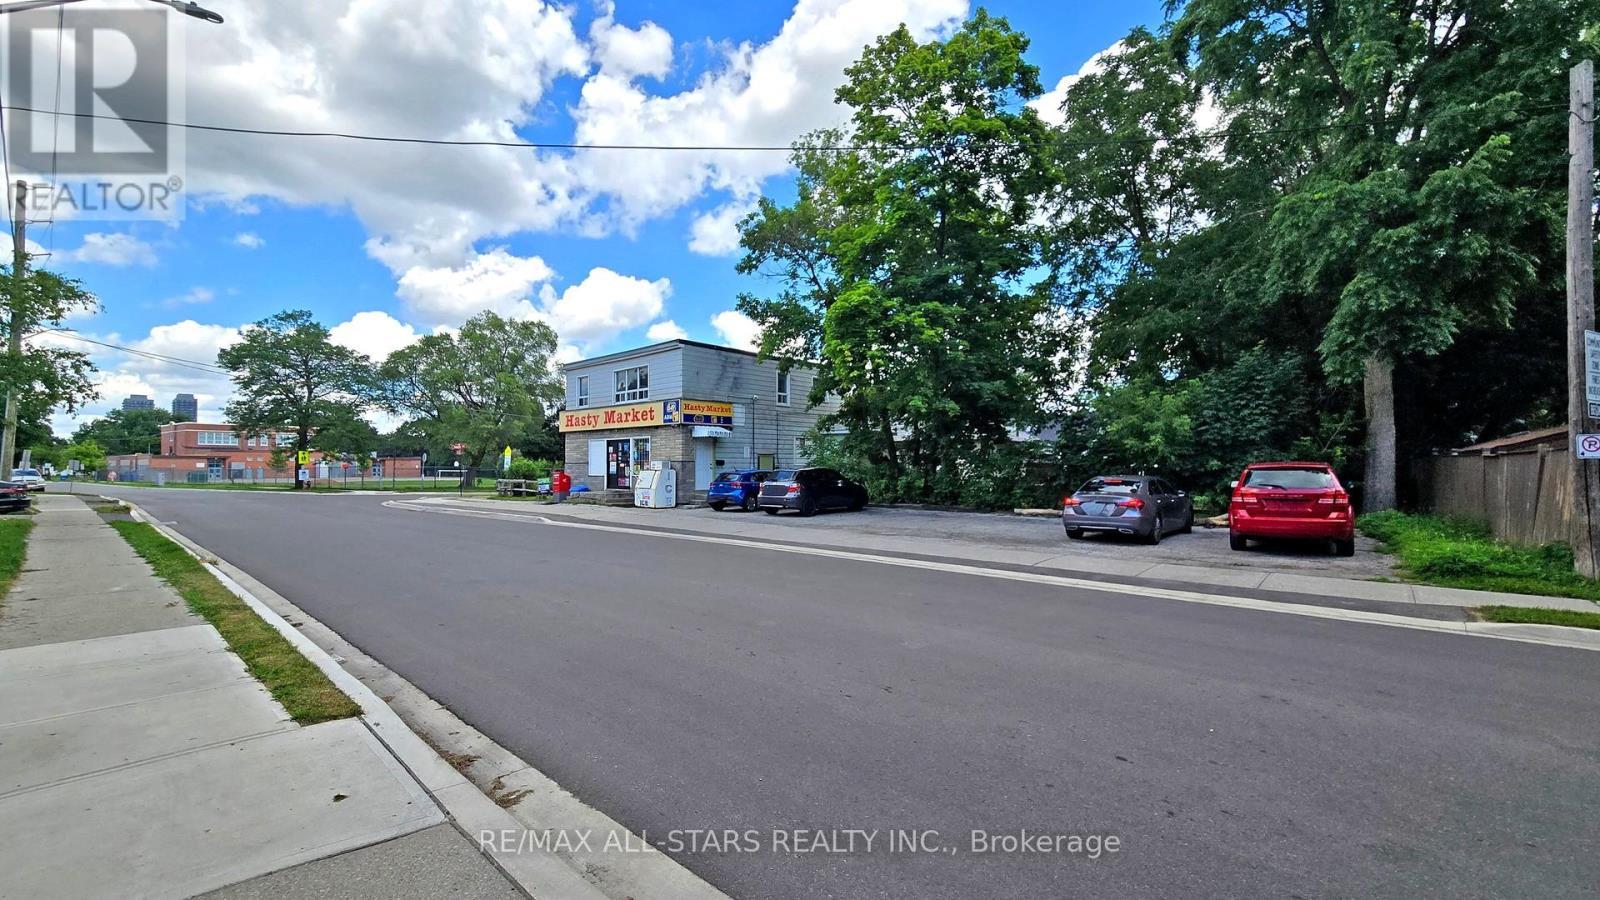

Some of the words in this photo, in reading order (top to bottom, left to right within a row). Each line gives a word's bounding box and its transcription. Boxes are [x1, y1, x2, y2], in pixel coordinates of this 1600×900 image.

[684, 403, 706, 412] Hasty
[707, 405, 732, 413] Market
[565, 411, 600, 428] Hasty
[603, 406, 655, 424] Market
